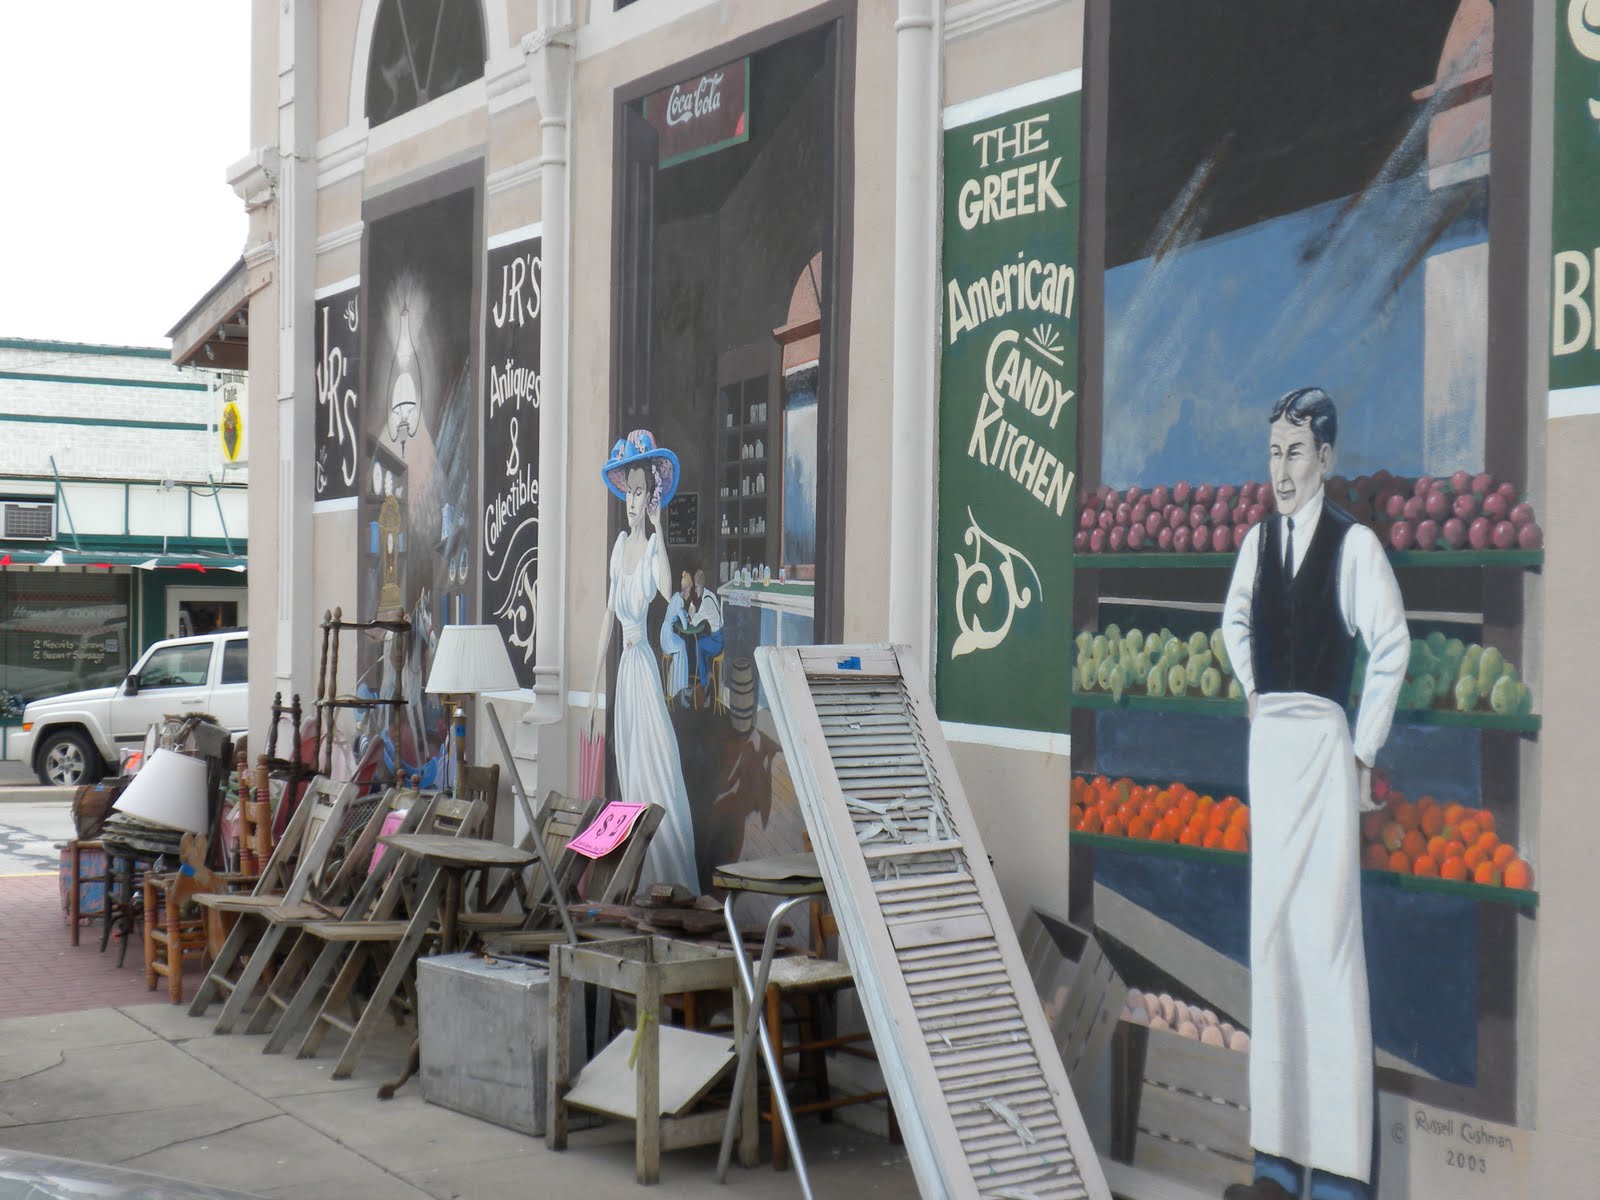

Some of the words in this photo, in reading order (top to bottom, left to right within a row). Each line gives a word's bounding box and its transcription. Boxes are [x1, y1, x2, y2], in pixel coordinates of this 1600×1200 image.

[972, 113, 1050, 169] THE
[958, 156, 1068, 230] GREEK
[492, 253, 541, 329] JR'S
[948, 250, 1075, 345] American
[316, 306, 357, 487] JR'S
[490, 358, 541, 419] Antiques
[985, 329, 1075, 429] CANDY
[506, 417, 519, 476] &
[967, 392, 1075, 517] KITCHEN
[33, 640, 40, 649] 2
[33, 651, 40, 660] 2
[1415, 1110, 1454, 1136] Russell
[1460, 1123, 1514, 1152] Cushman
[1446, 1150, 1487, 1174] 2003
